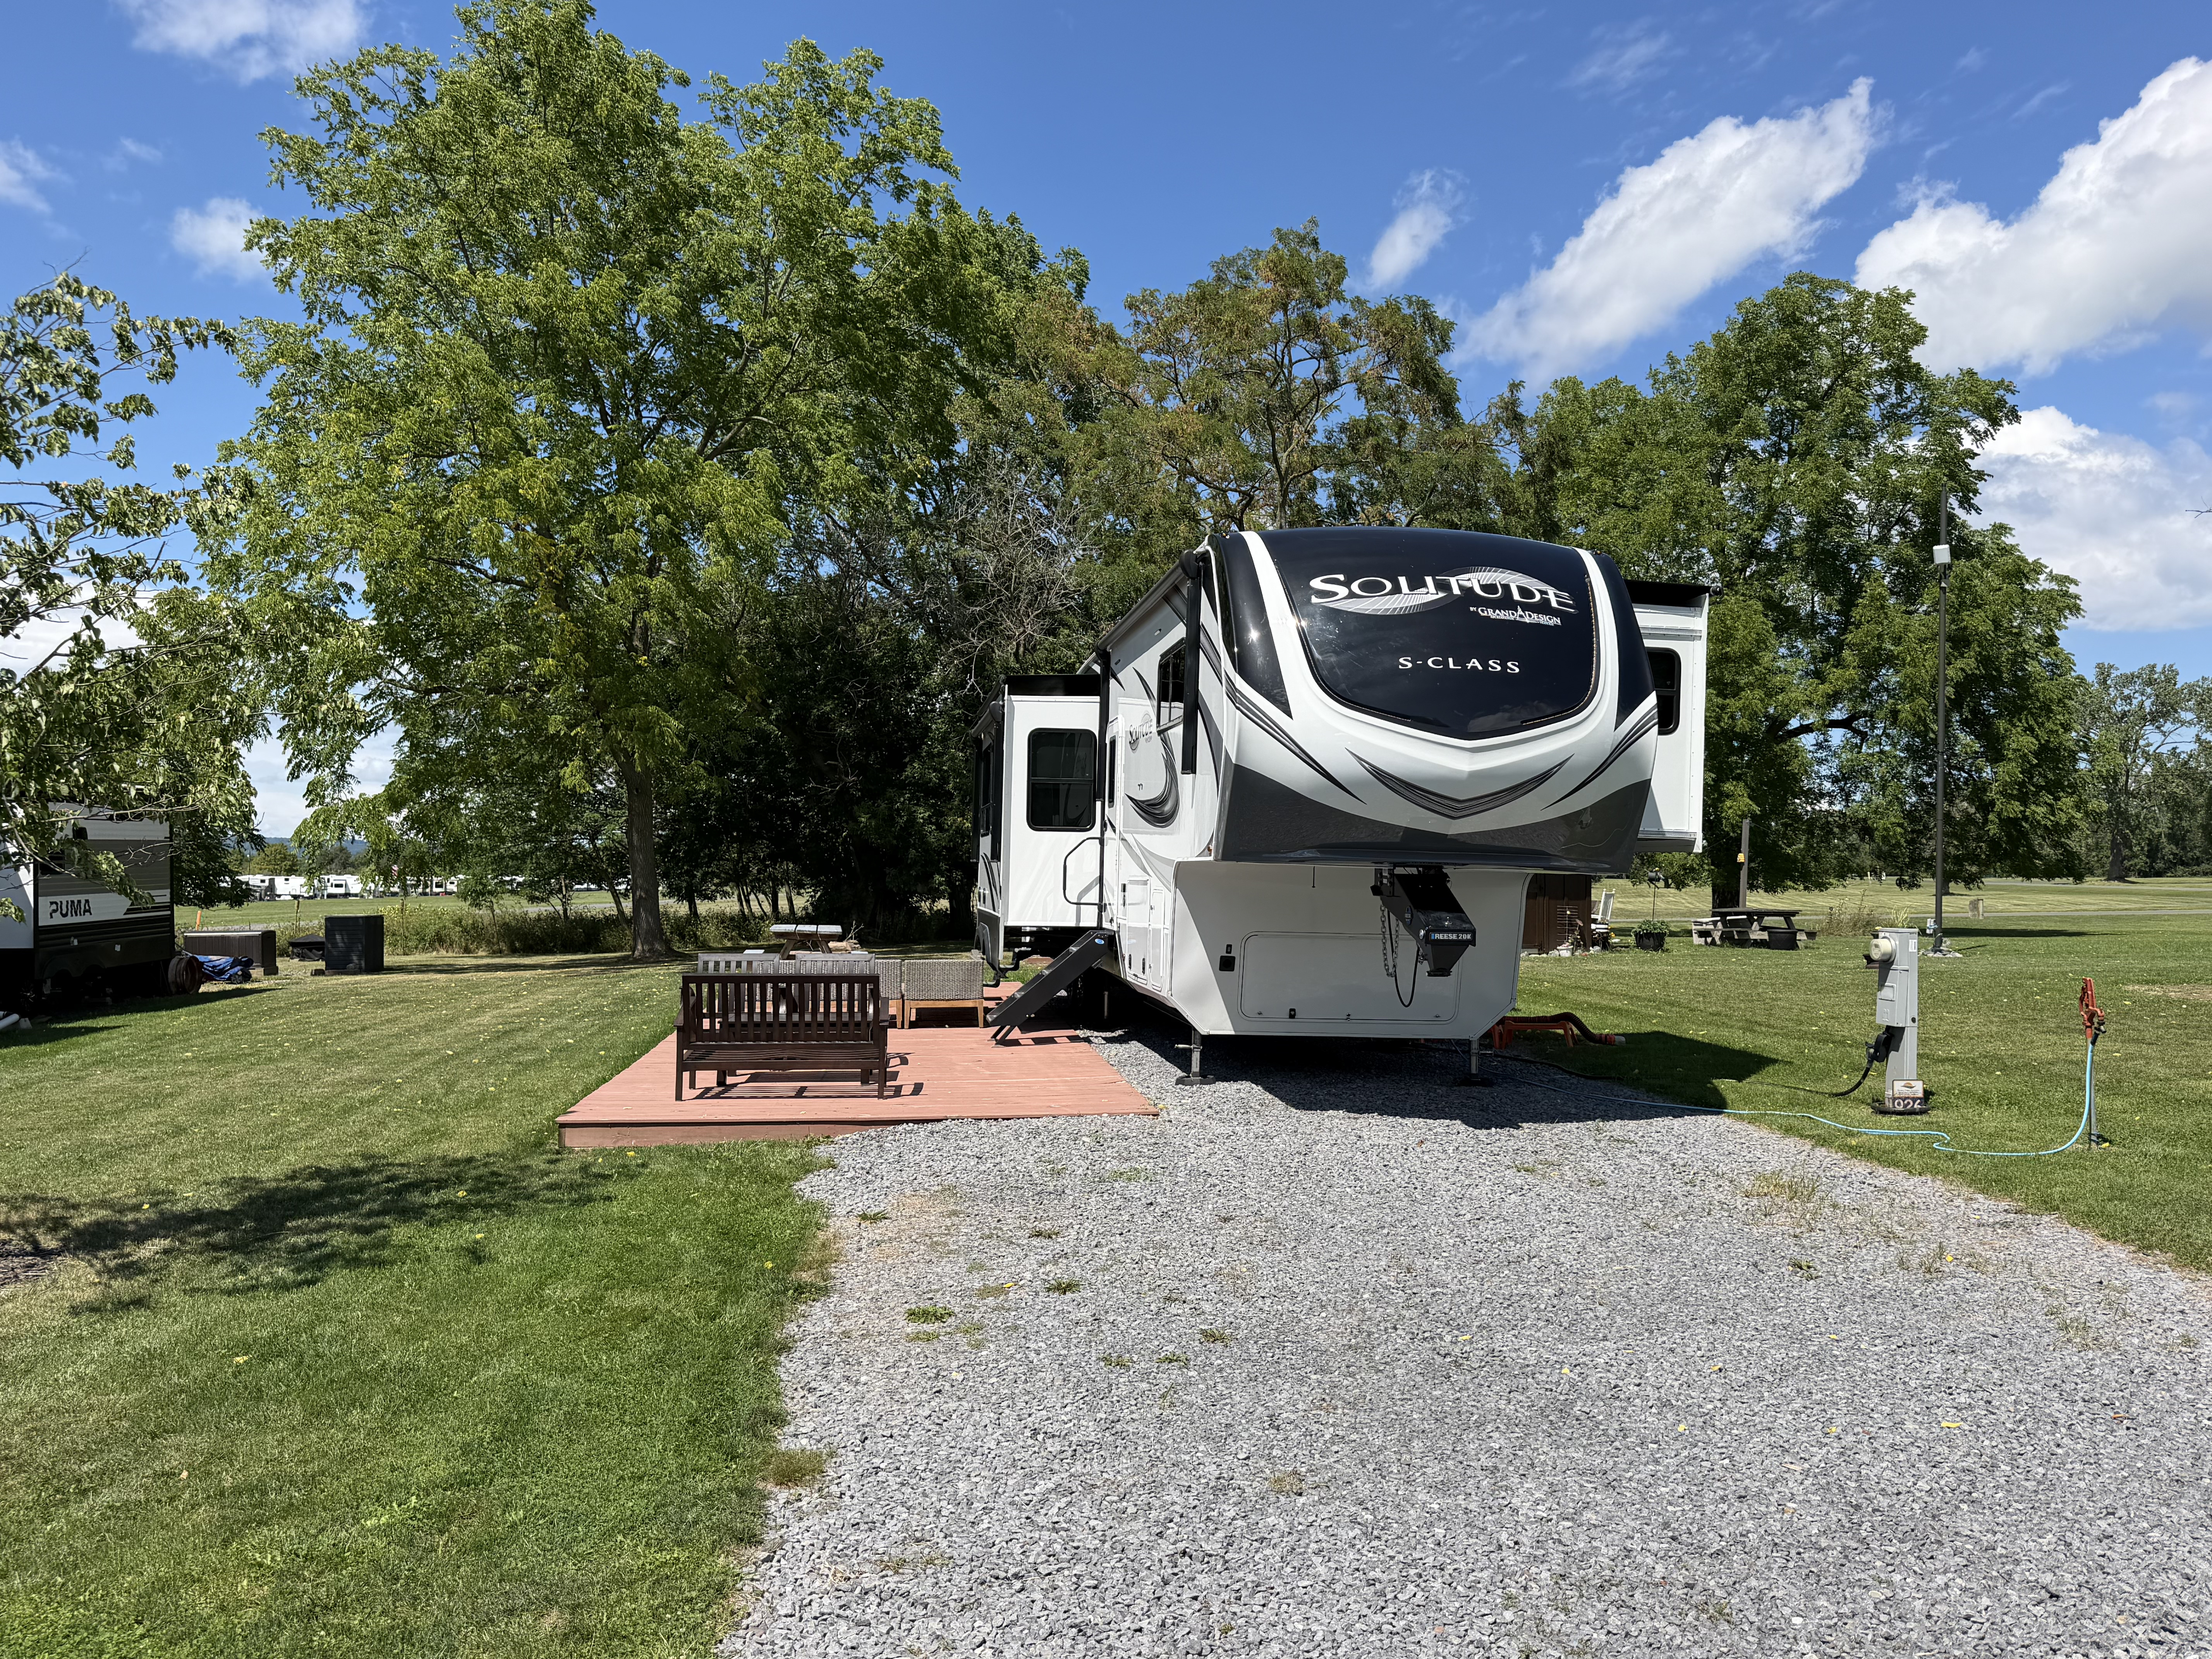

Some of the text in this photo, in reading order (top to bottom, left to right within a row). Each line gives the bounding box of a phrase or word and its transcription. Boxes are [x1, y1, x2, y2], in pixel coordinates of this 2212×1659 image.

[1310, 574, 1577, 613] SOLITUDE
[1478, 607, 1516, 617] GRAND
[1524, 611, 1561, 624] DESIGN
[1398, 657, 1520, 673] S-CLASS
[49, 899, 92, 919] PUMA
